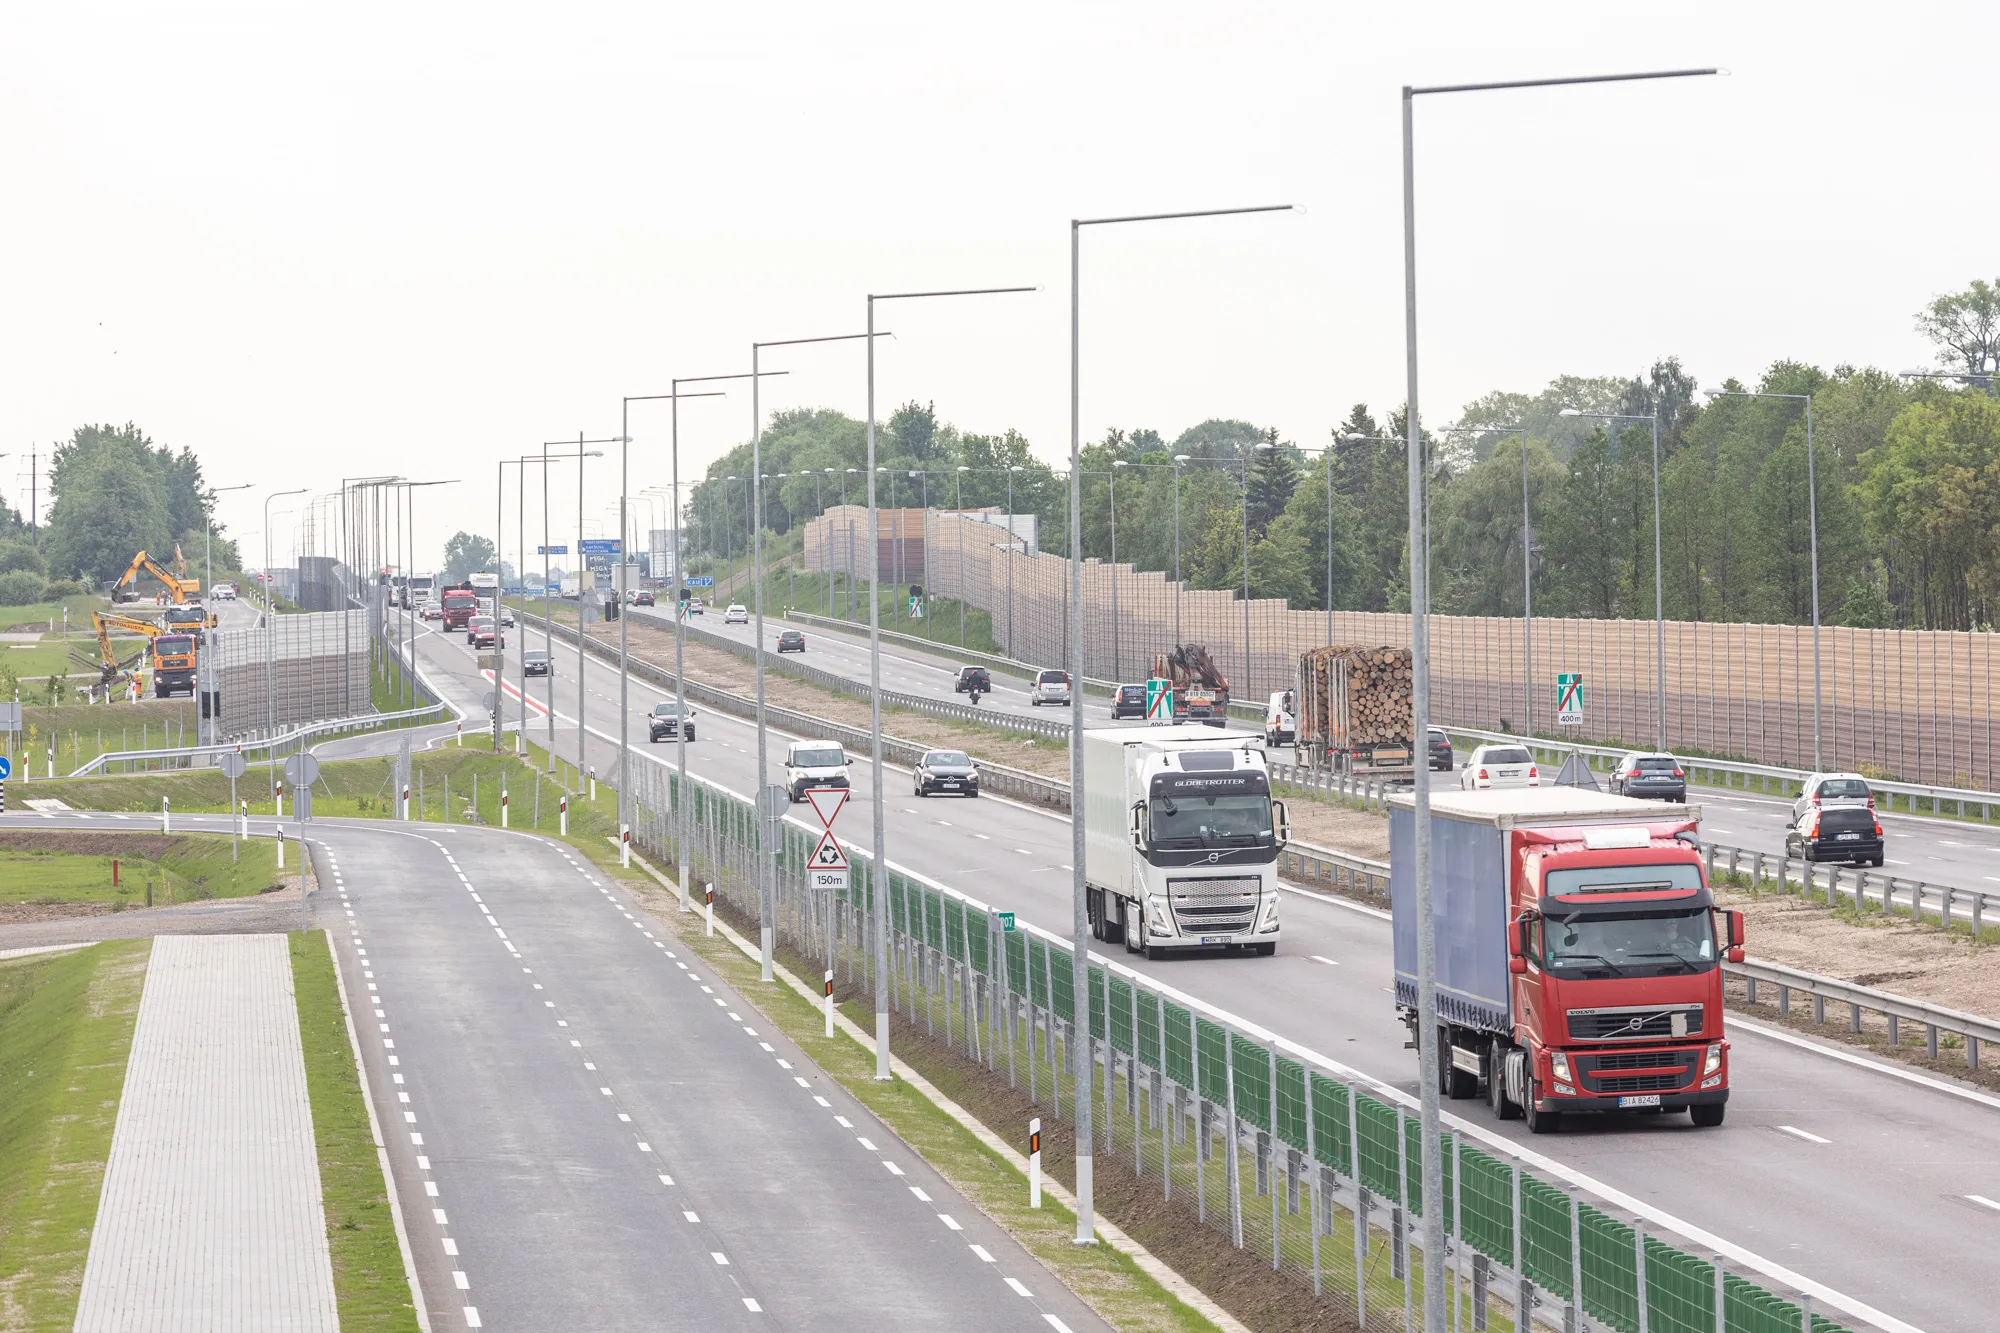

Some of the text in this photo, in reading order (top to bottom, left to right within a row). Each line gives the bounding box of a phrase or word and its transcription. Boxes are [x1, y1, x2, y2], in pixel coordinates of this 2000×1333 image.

[108, 620, 144, 631] AUTOKAUSTA
[816, 875, 842, 885] 150m
[1623, 1095, 1659, 1105] BIA 82426
